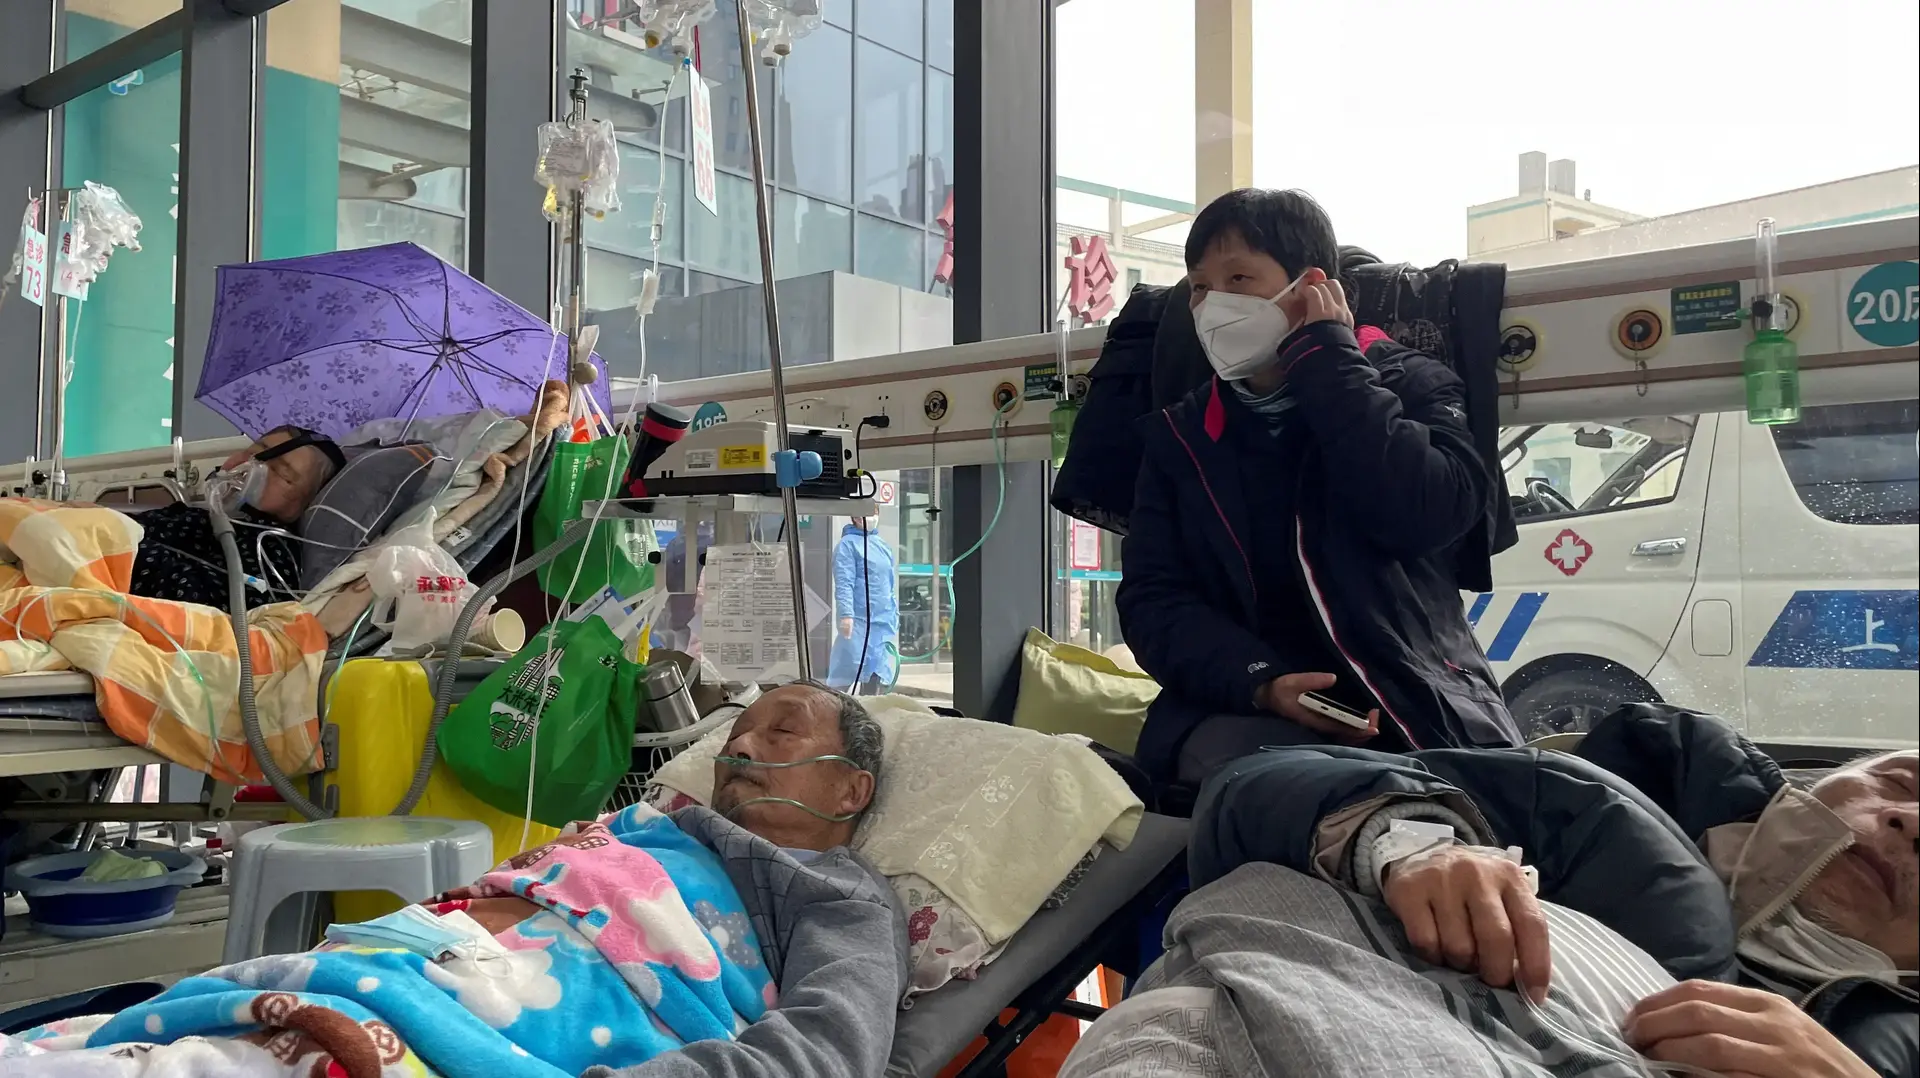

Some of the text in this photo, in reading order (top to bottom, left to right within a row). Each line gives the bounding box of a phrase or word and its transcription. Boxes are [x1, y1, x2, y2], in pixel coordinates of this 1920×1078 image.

[26, 266, 42, 299] 73
[571, 457, 580, 480] RICE
[1842, 608, 1900, 653] 上
